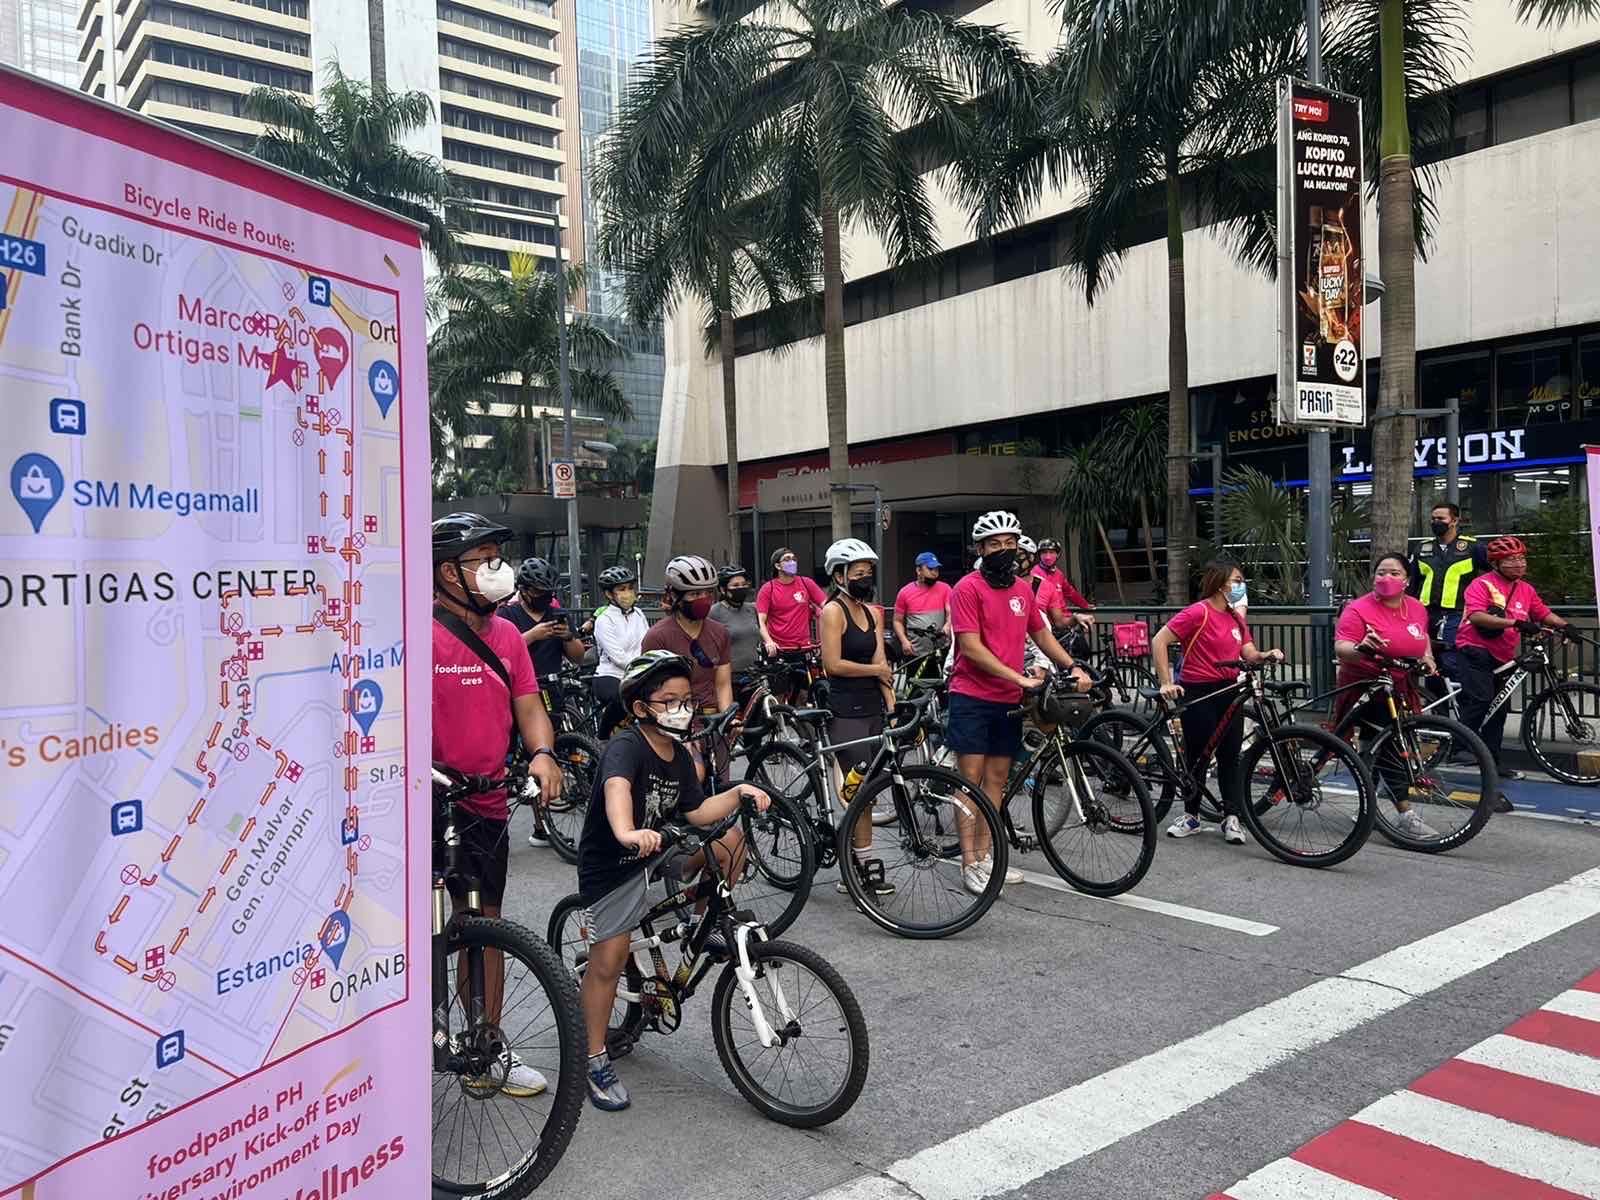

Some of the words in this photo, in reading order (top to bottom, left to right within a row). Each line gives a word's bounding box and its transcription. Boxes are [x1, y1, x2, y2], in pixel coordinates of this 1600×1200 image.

[1294, 103, 1307, 113] TRY
[1296, 130, 1312, 141] ANG
[1313, 133, 1338, 144] KOPIKO
[1305, 146, 1345, 162] KOPIKO
[1297, 162, 1334, 177] LUCKY
[1334, 165, 1356, 179] DAY
[1304, 180, 1314, 189] NA
[1315, 181, 1348, 191] NGAYON!
[124, 183, 192, 221] Bicycle
[198, 206, 237, 235] Ride
[243, 222, 296, 253] Route:
[62, 215, 136, 260] Guadix
[143, 243, 163, 267] Dr
[61, 260, 82, 289] Dr
[60, 297, 81, 358] Bank
[178, 294, 258, 334] Marco
[133, 322, 230, 364] Ortigas
[73, 480, 120, 508] SM
[129, 483, 259, 517] Megamall
[192, 569, 318, 600] CENTER
[434, 664, 482, 684] foodpanda
[461, 676, 483, 686] cares
[39, 725, 160, 764] Candies
[370, 767, 385, 784] St
[226, 860, 260, 903] Gen.
[250, 796, 295, 861] Malvar
[231, 893, 265, 936] Gen.
[260, 807, 314, 887] Capinpin
[216, 942, 314, 996] Estancia
[329, 952, 406, 1004] ORANB
[120, 1077, 149, 1108] St
[147, 1104, 269, 1179] foodpanda
[276, 1081, 304, 1113] PH
[244, 1101, 319, 1161] Kick-off
[325, 1074, 374, 1115] Event
[326, 1113, 361, 1144] Day
